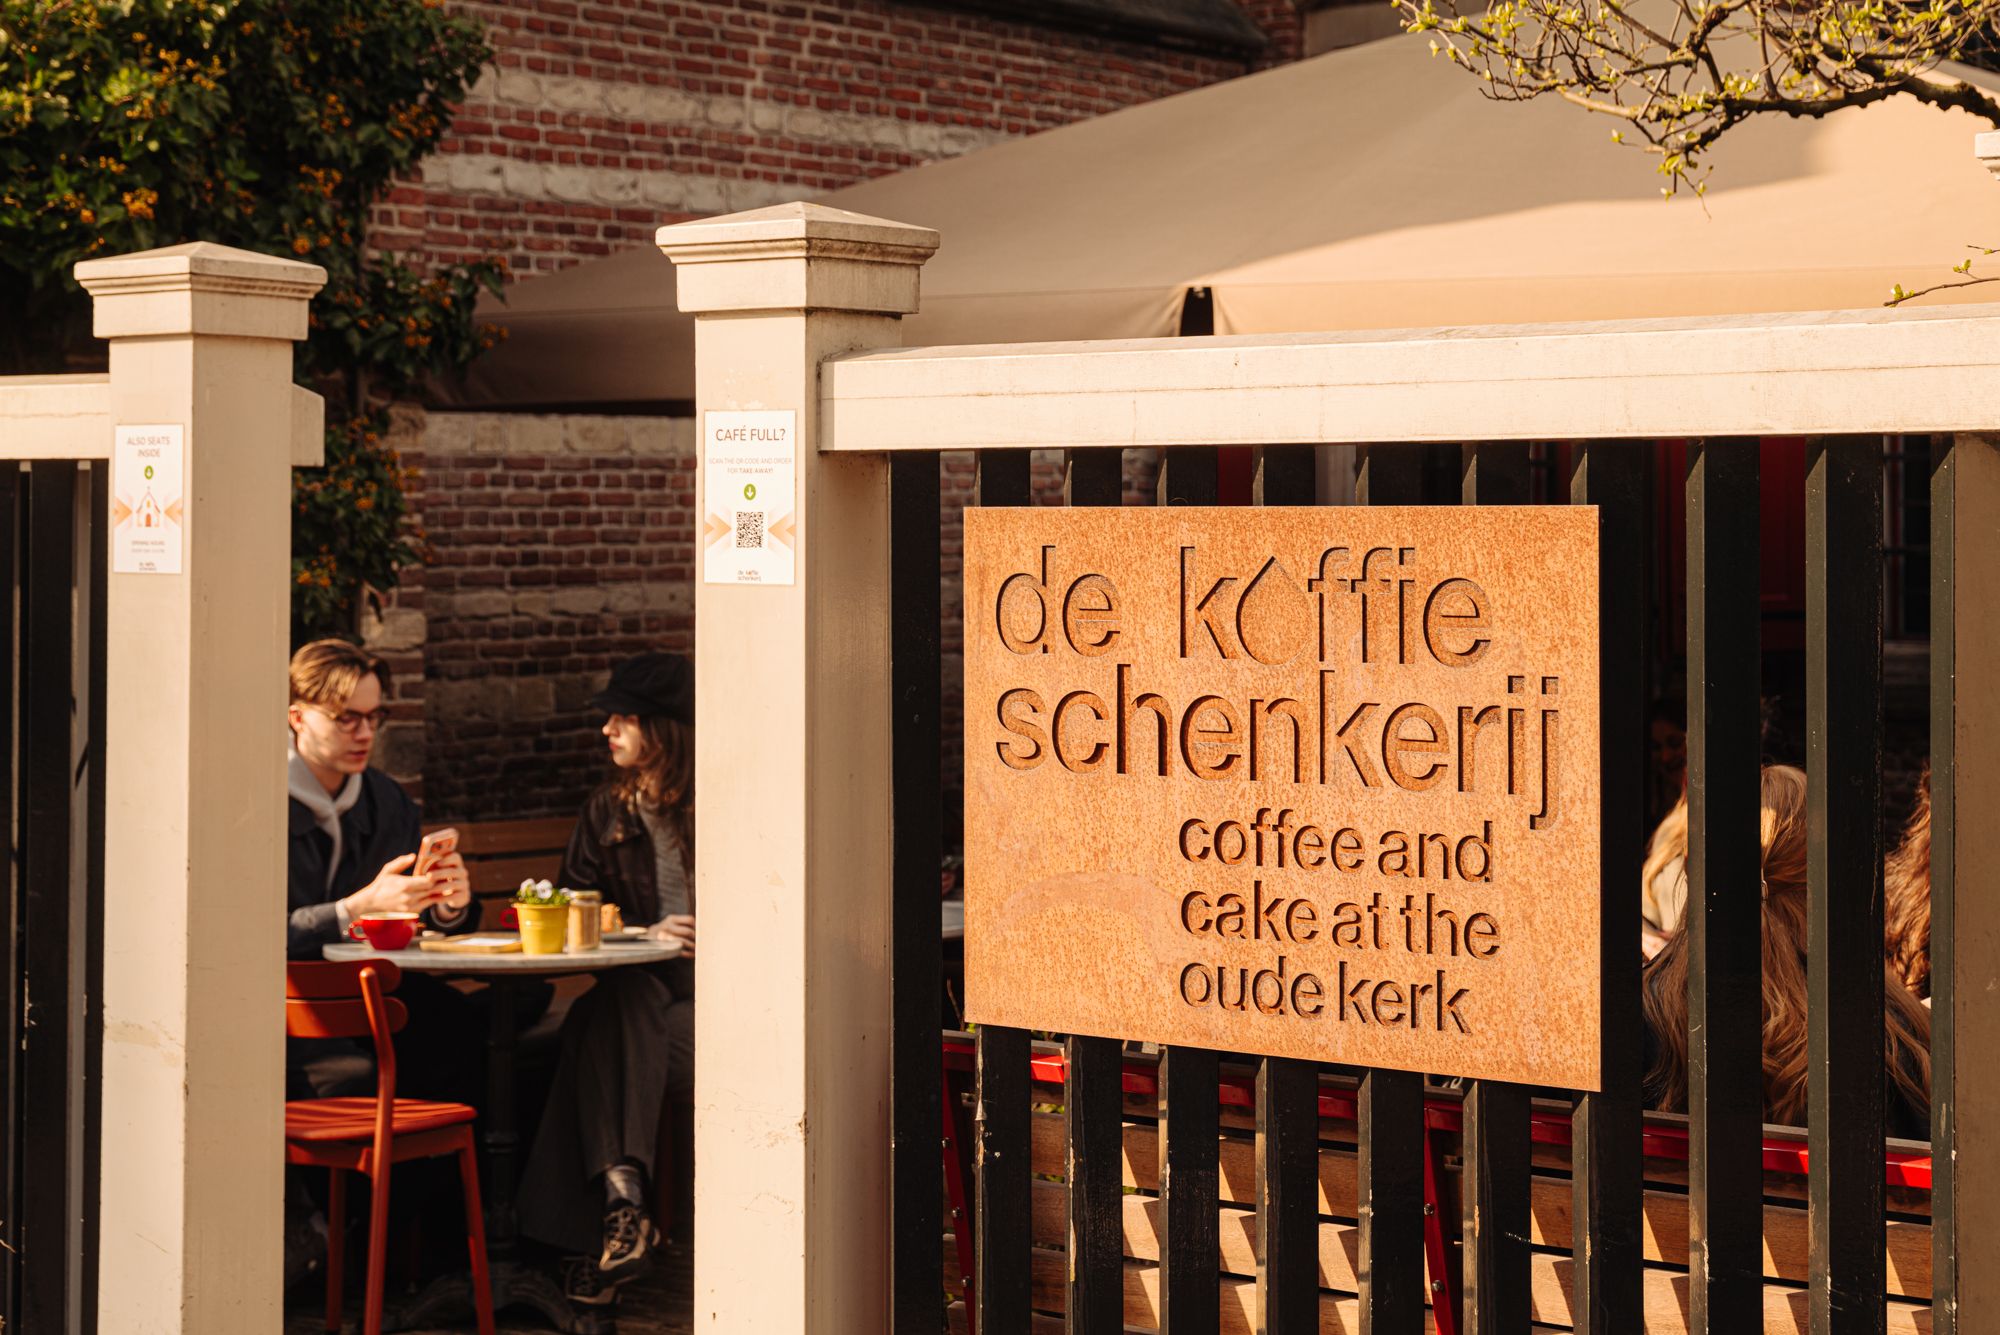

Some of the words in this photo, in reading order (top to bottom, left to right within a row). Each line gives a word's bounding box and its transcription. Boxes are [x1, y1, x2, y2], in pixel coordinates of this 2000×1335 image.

[127, 436, 146, 446] ALSO
[147, 436, 170, 446] SEATS
[137, 449, 161, 458] INSIDE
[716, 425, 746, 441] CAFÉ
[750, 428, 786, 441] FULL?
[995, 545, 1122, 657] de
[1179, 545, 1493, 668] koffie
[995, 663, 1561, 830] schenkerij
[1178, 807, 1366, 873] coffee
[1377, 820, 1494, 884] and
[1180, 880, 1320, 944] cake
[1331, 892, 1389, 951] at
[1399, 892, 1501, 960] the
[1179, 955, 1325, 1020] oude
[1338, 960, 1473, 1036] kerk
